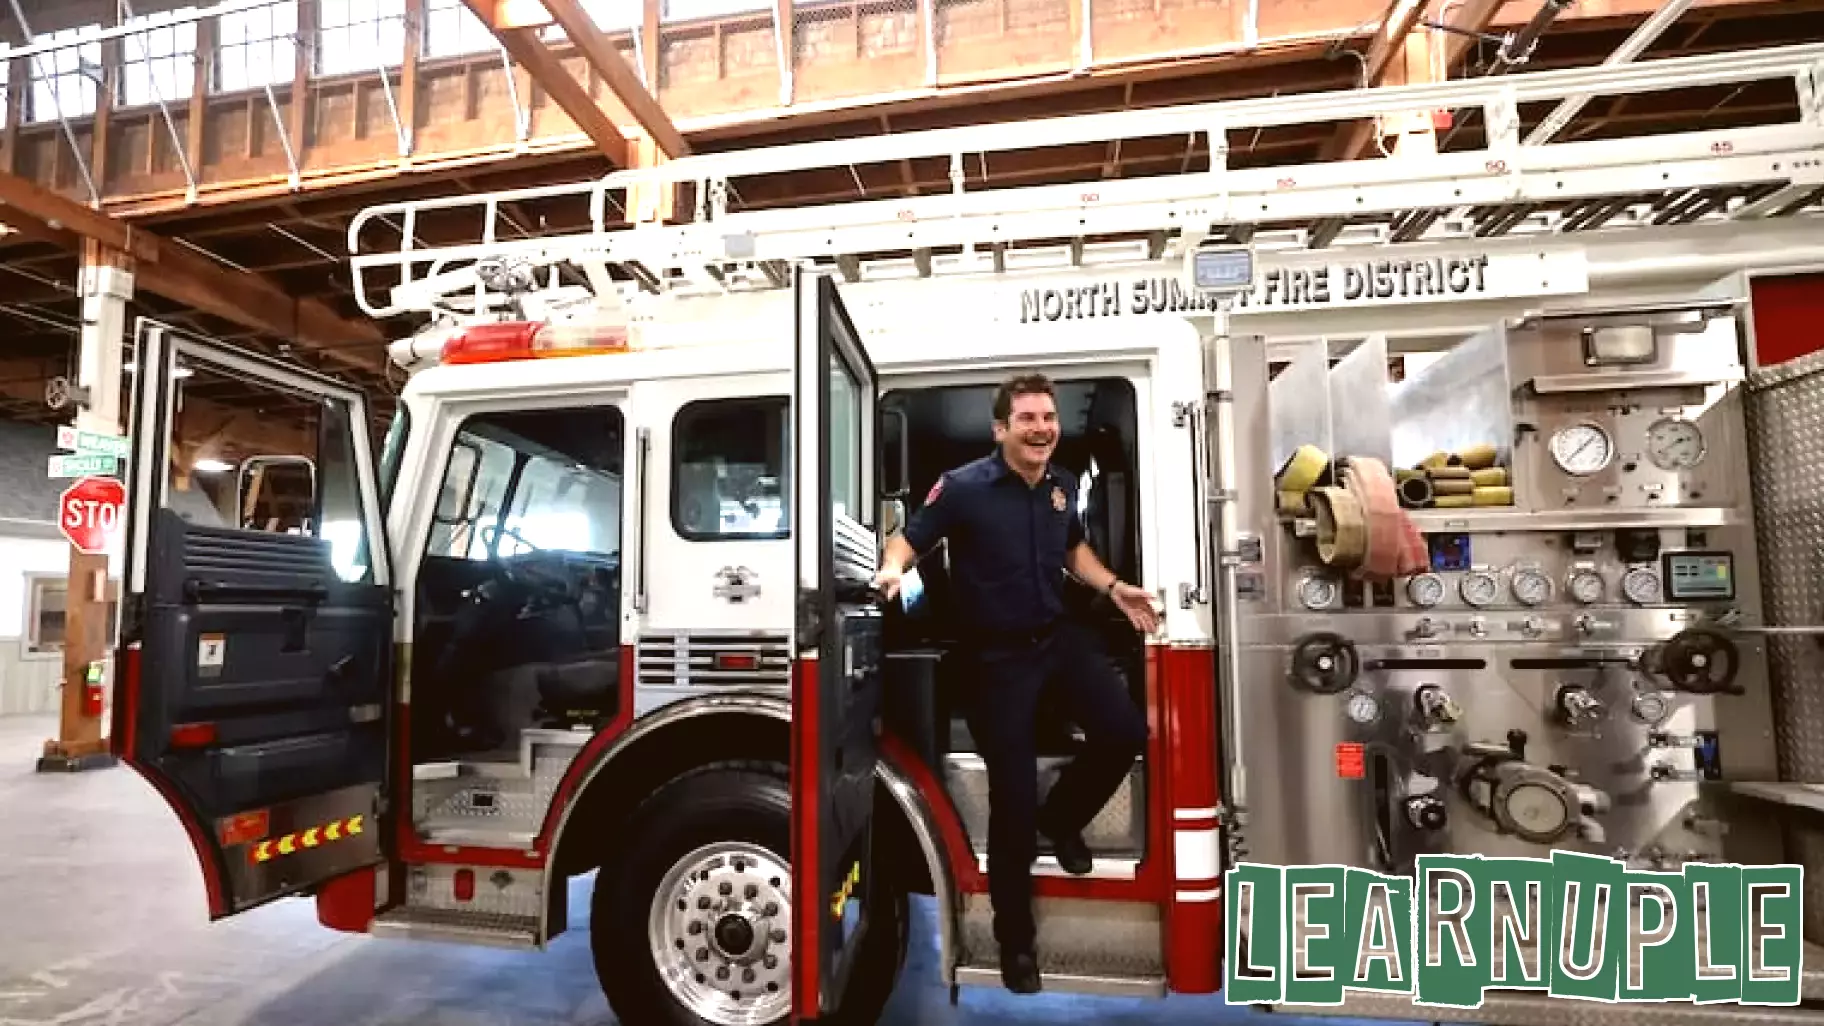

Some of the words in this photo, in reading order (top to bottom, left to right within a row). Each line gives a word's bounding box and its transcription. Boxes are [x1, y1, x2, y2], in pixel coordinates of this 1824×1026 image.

[1020, 281, 1120, 324] NORTH
[1130, 277, 1256, 316] SUMT
[1264, 264, 1331, 305] FIRE
[1343, 253, 1489, 300] DISTRICT
[65, 498, 127, 532] STO
